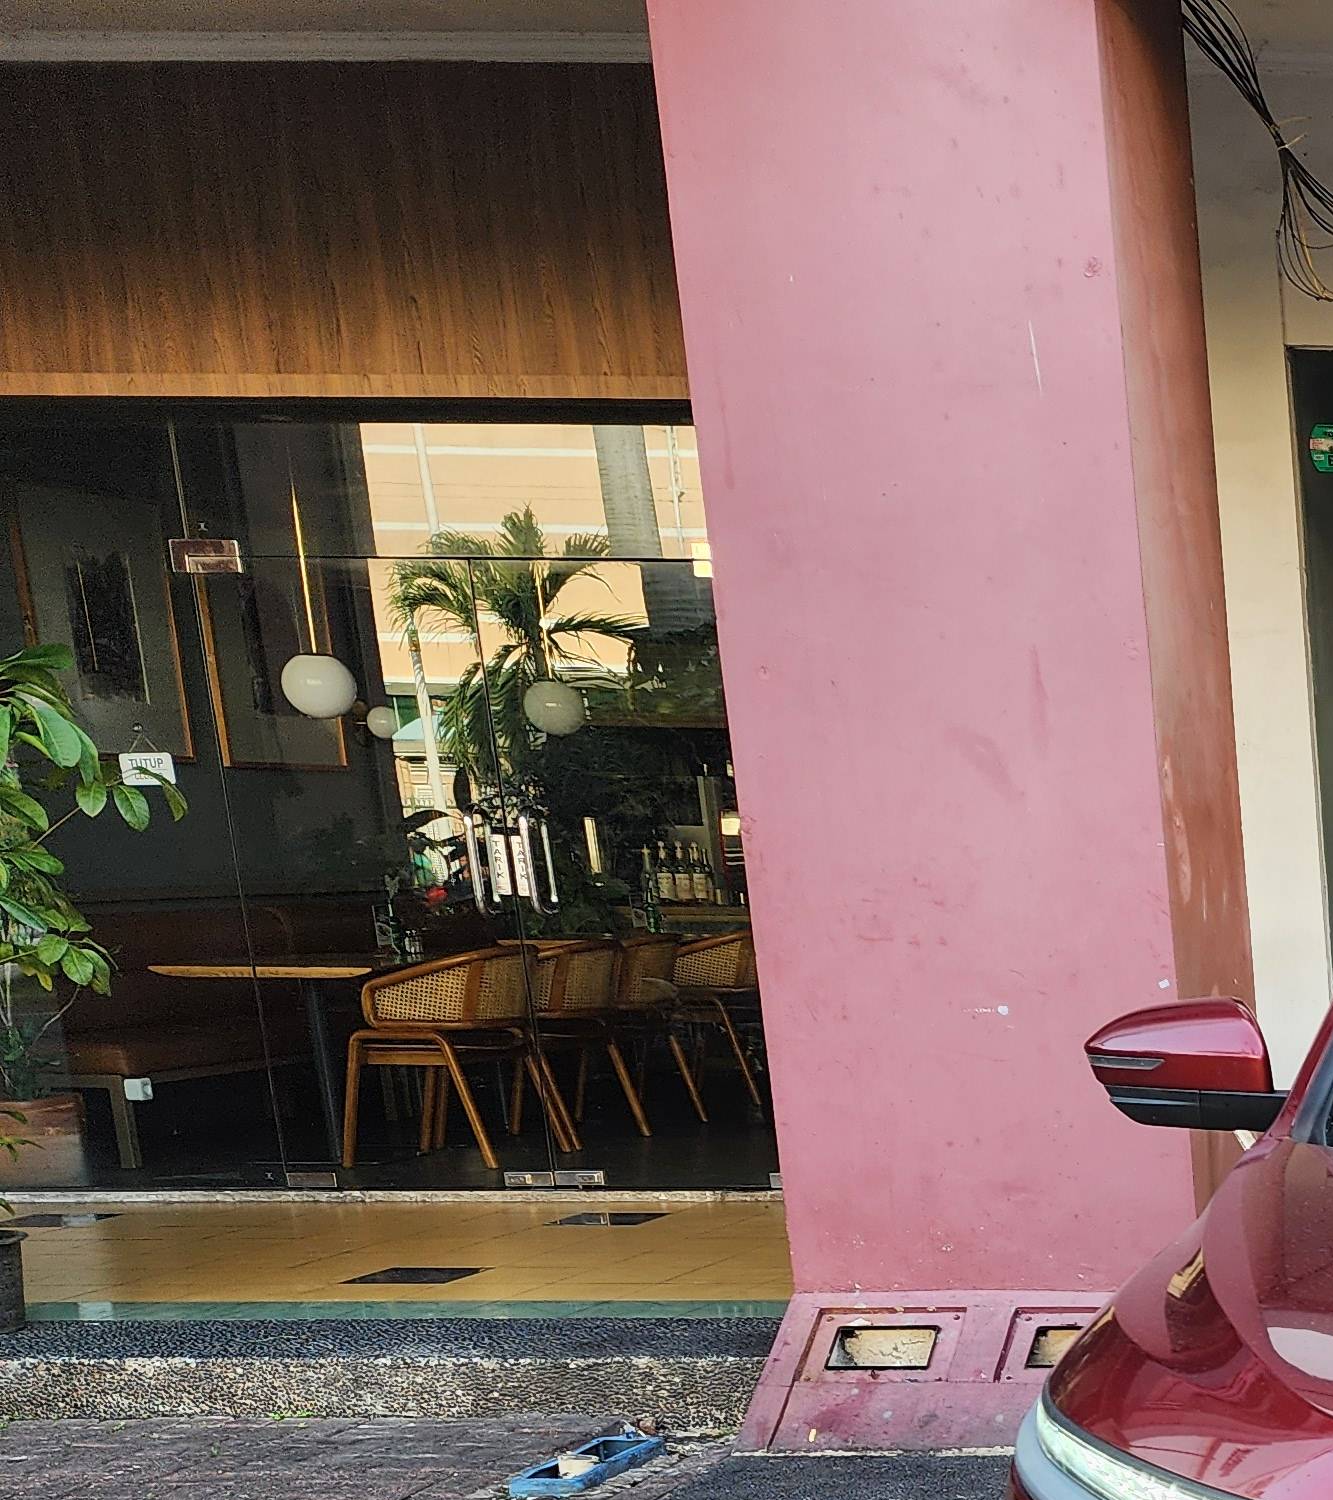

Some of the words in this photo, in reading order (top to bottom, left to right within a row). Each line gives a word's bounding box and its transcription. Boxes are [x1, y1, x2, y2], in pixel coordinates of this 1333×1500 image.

[128, 757, 164, 768] TUTUP
[492, 840, 505, 879] TARIK
[515, 841, 528, 880] TARIK
